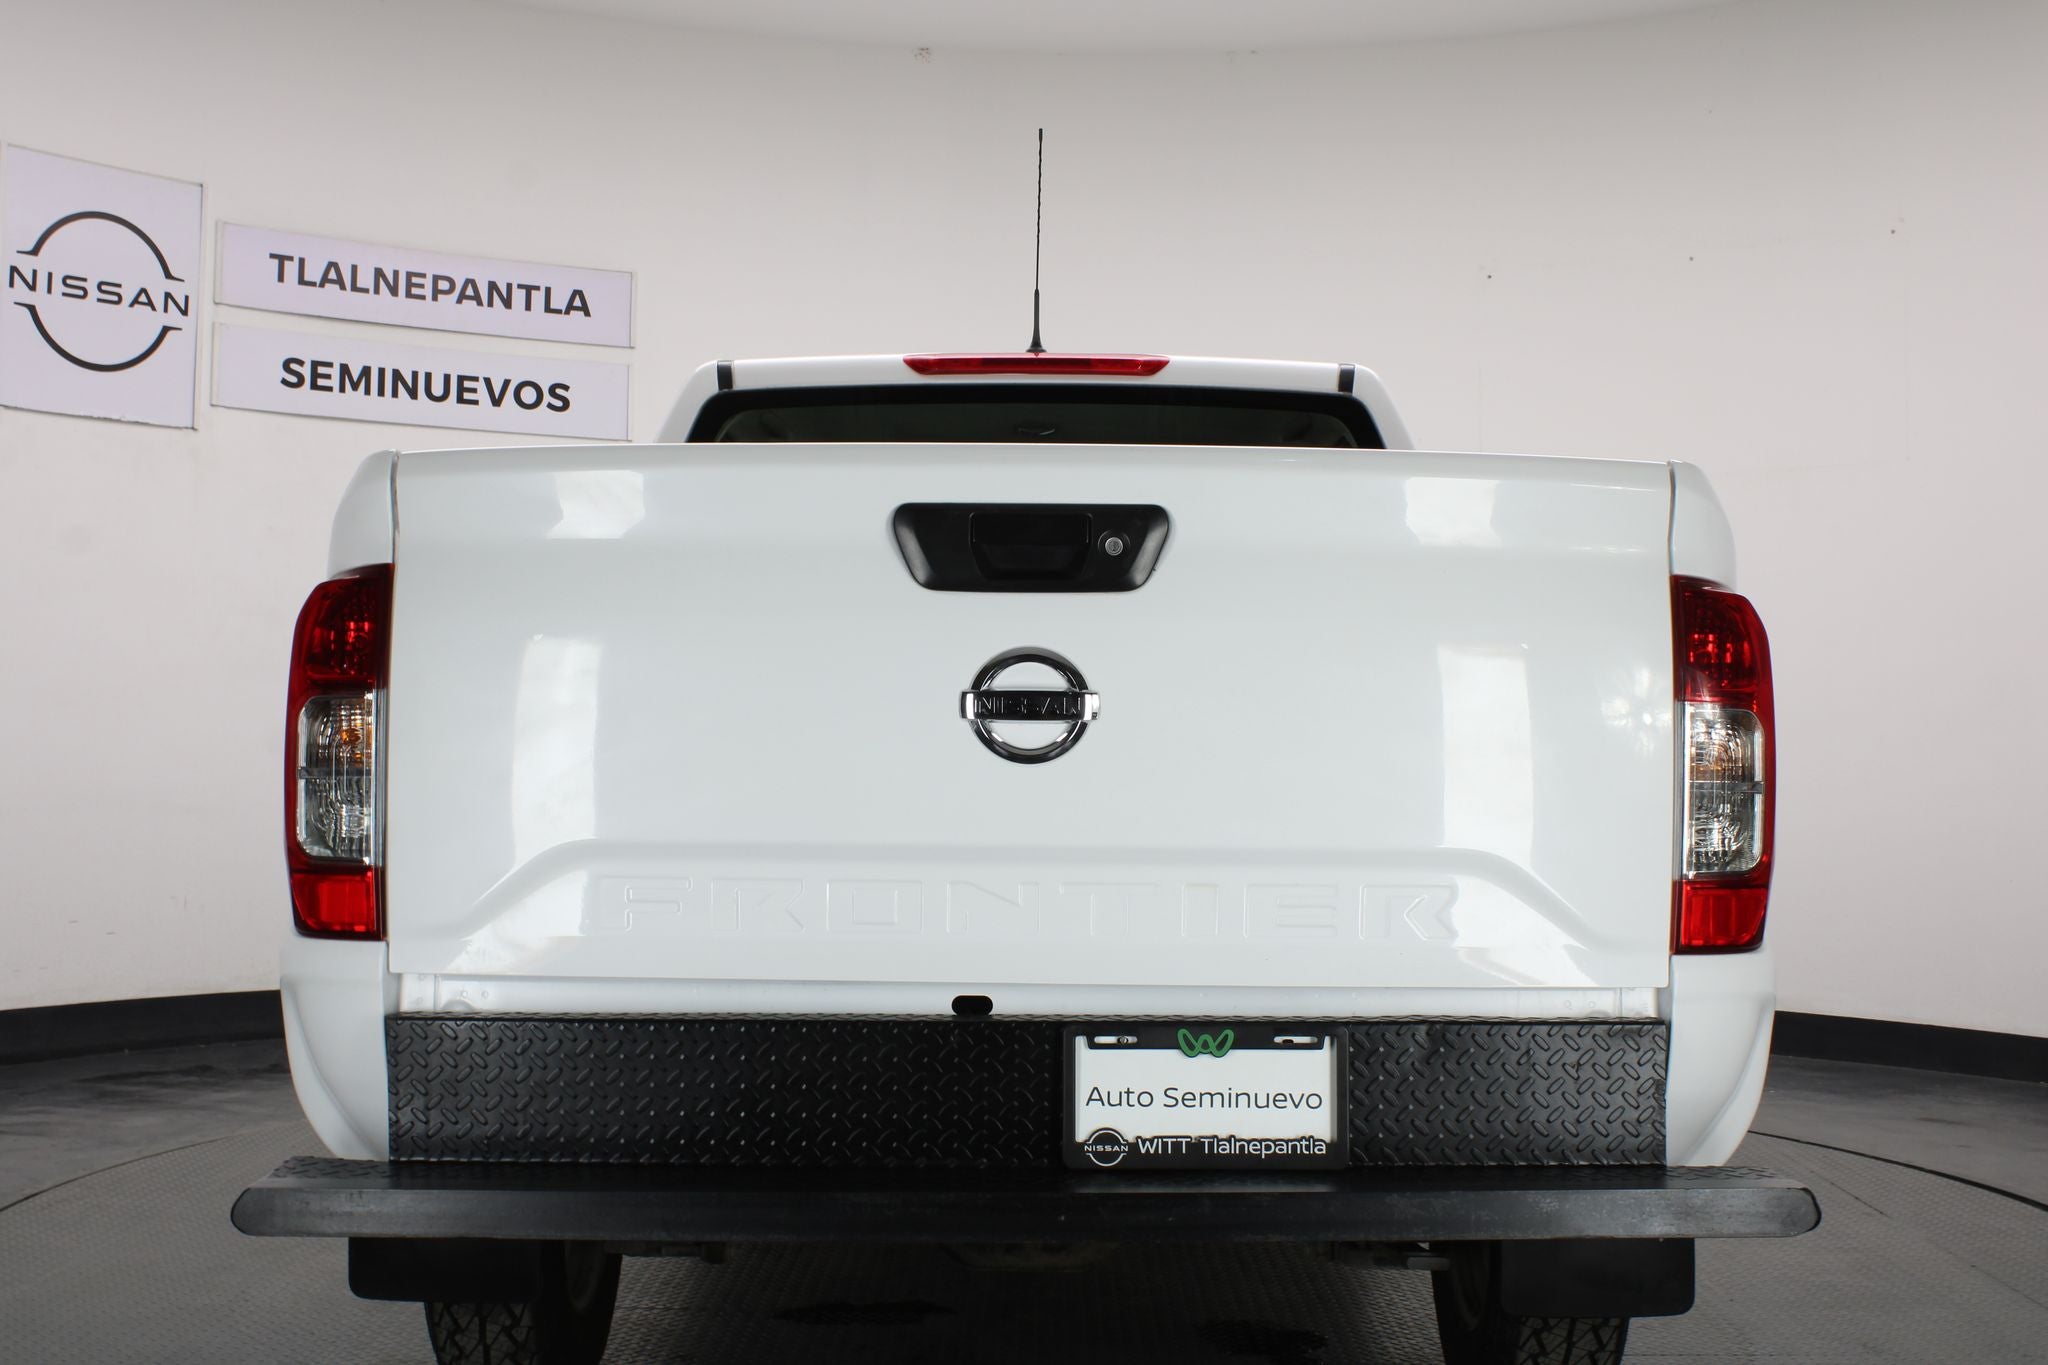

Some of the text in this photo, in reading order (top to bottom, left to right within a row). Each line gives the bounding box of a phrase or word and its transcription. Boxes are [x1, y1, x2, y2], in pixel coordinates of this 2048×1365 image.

[8, 264, 190, 317] NISSAN
[269, 252, 592, 318] TLALNEPANTLA
[280, 356, 571, 412] SEMINUEVOS
[595, 875, 1458, 940] FRONTIER
[1086, 1086, 1323, 1110] Auto Seminuevo
[1084, 1144, 1129, 1153] NISSAN
[1137, 1136, 1327, 1159] WITT Tlalnepantla
